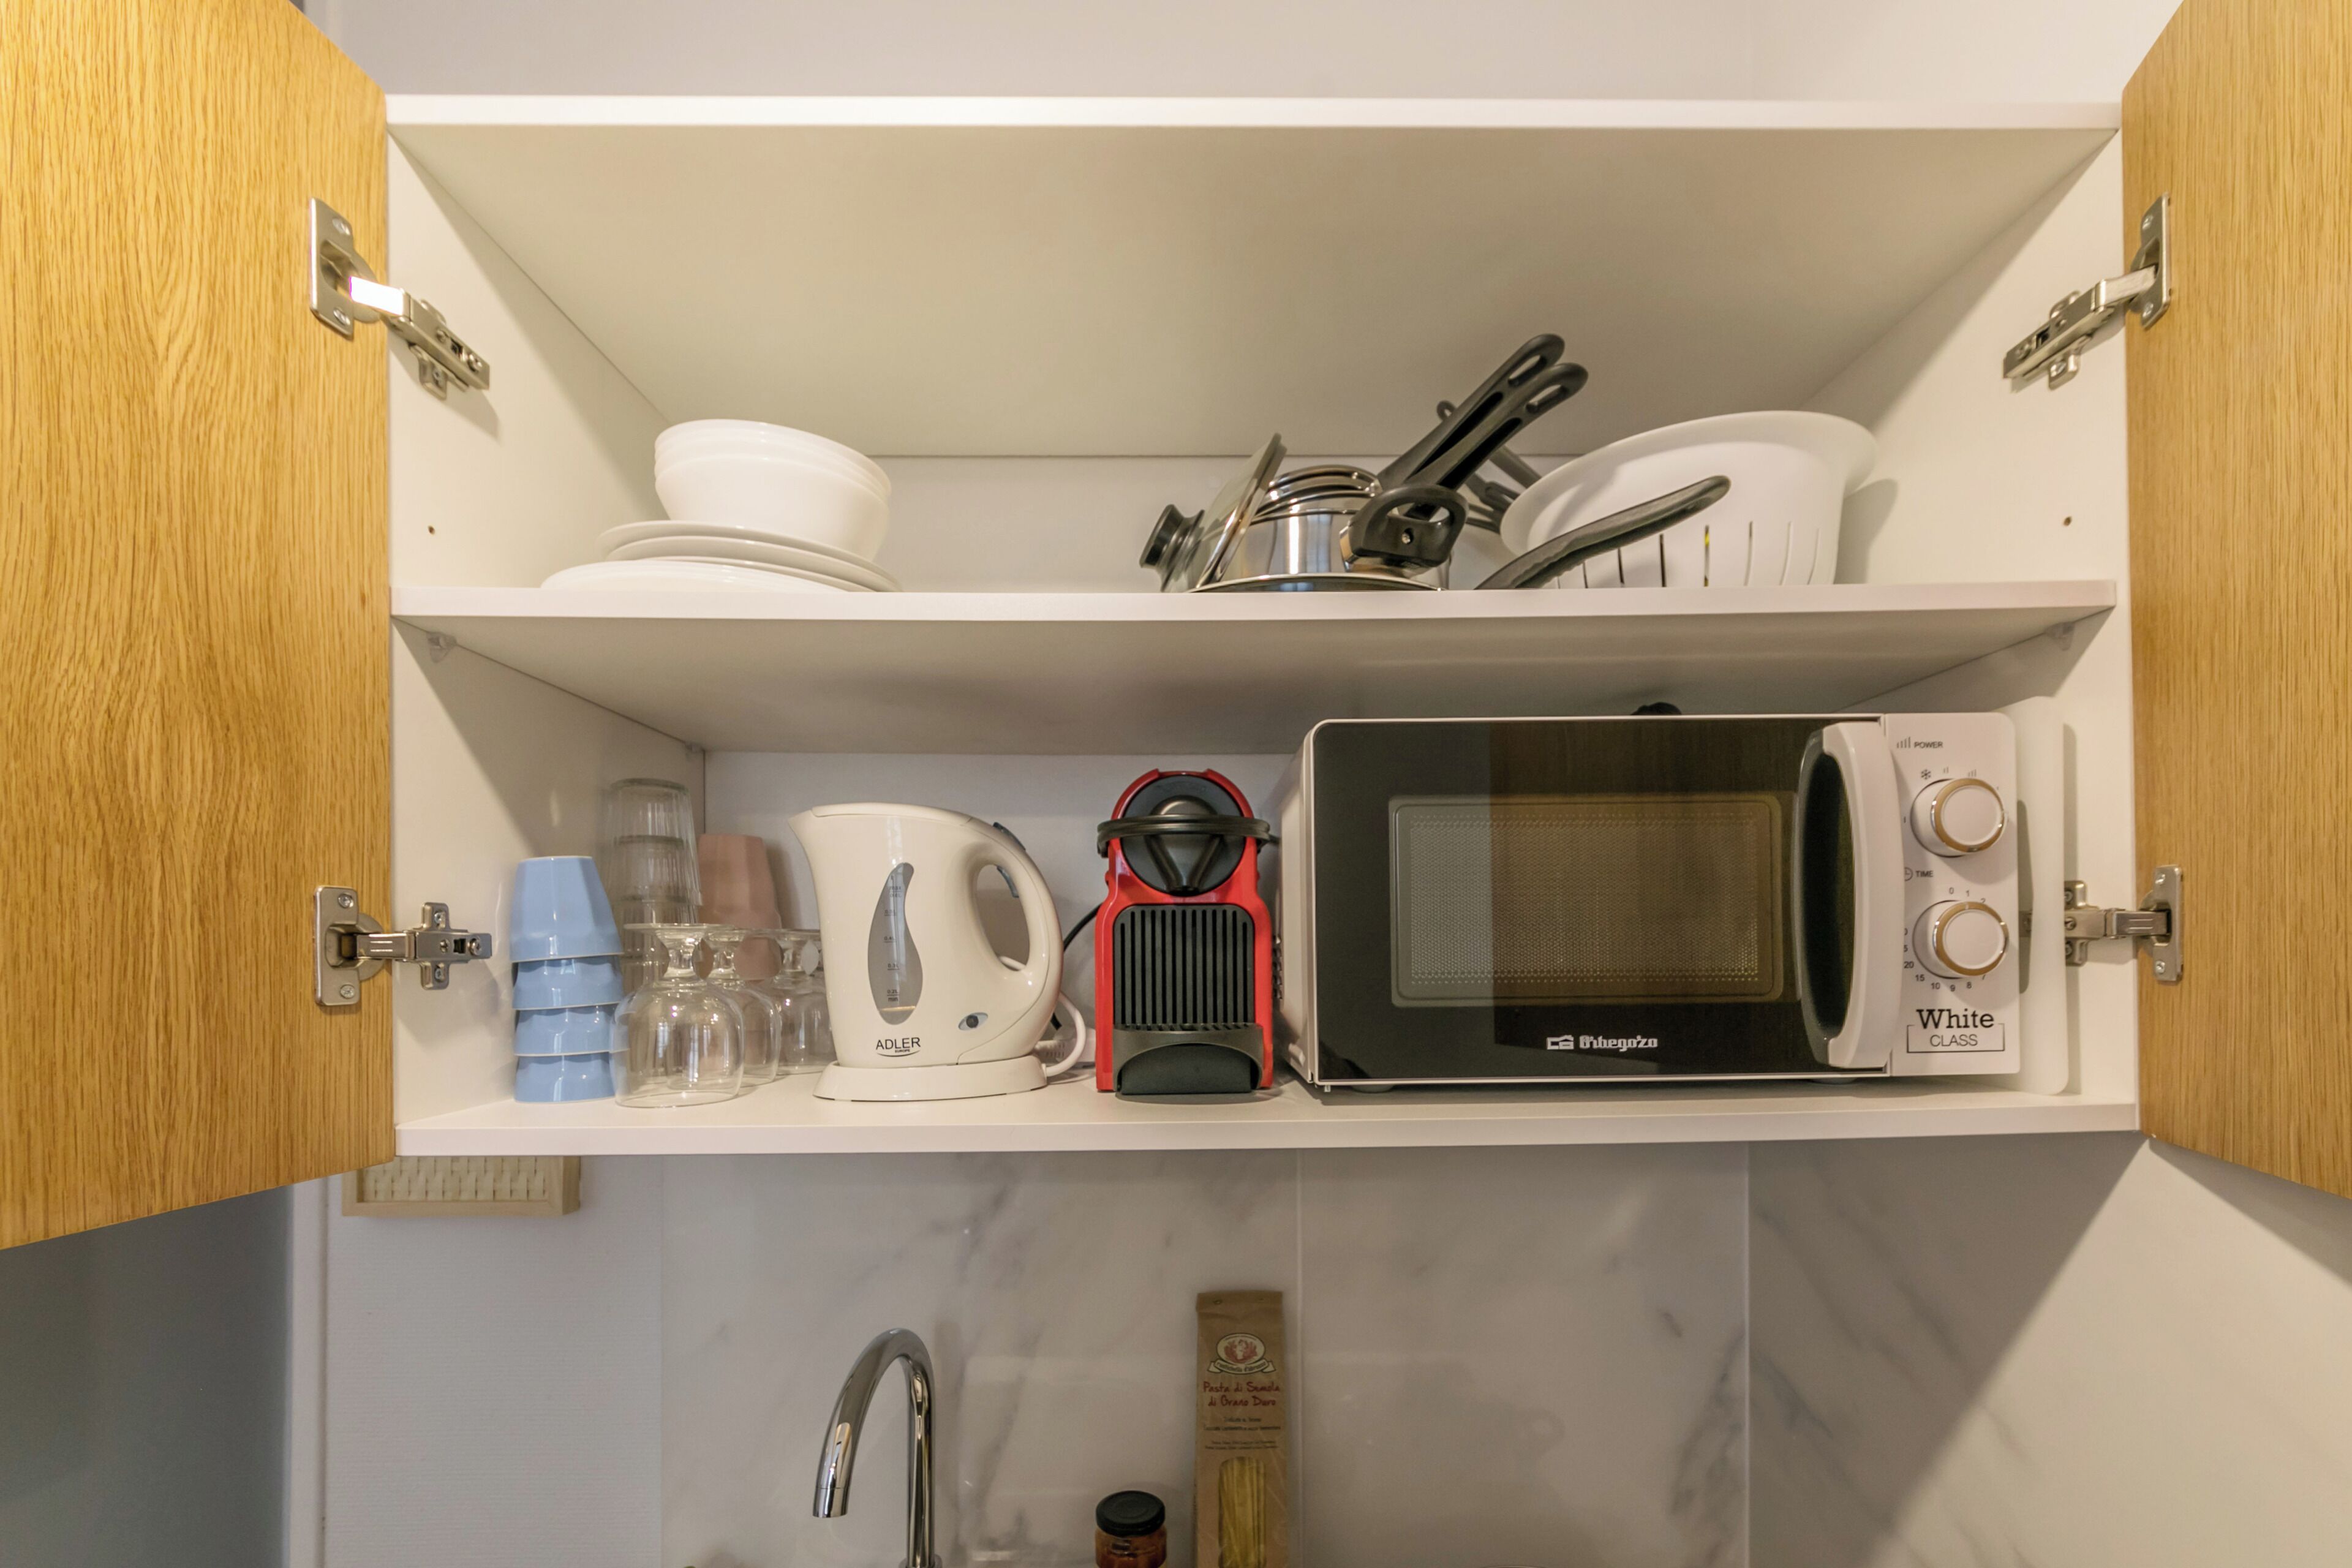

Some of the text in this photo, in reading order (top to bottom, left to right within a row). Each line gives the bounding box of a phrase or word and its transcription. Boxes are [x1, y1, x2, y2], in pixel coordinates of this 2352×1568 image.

[1916, 1008, 1994, 1029] White
[876, 1037, 921, 1050] ADLER
[1929, 1034, 1978, 1046] CLASS
[1203, 1381, 1280, 1392] Pasta di Semola
[1208, 1394, 1276, 1406] di Grano Duro
